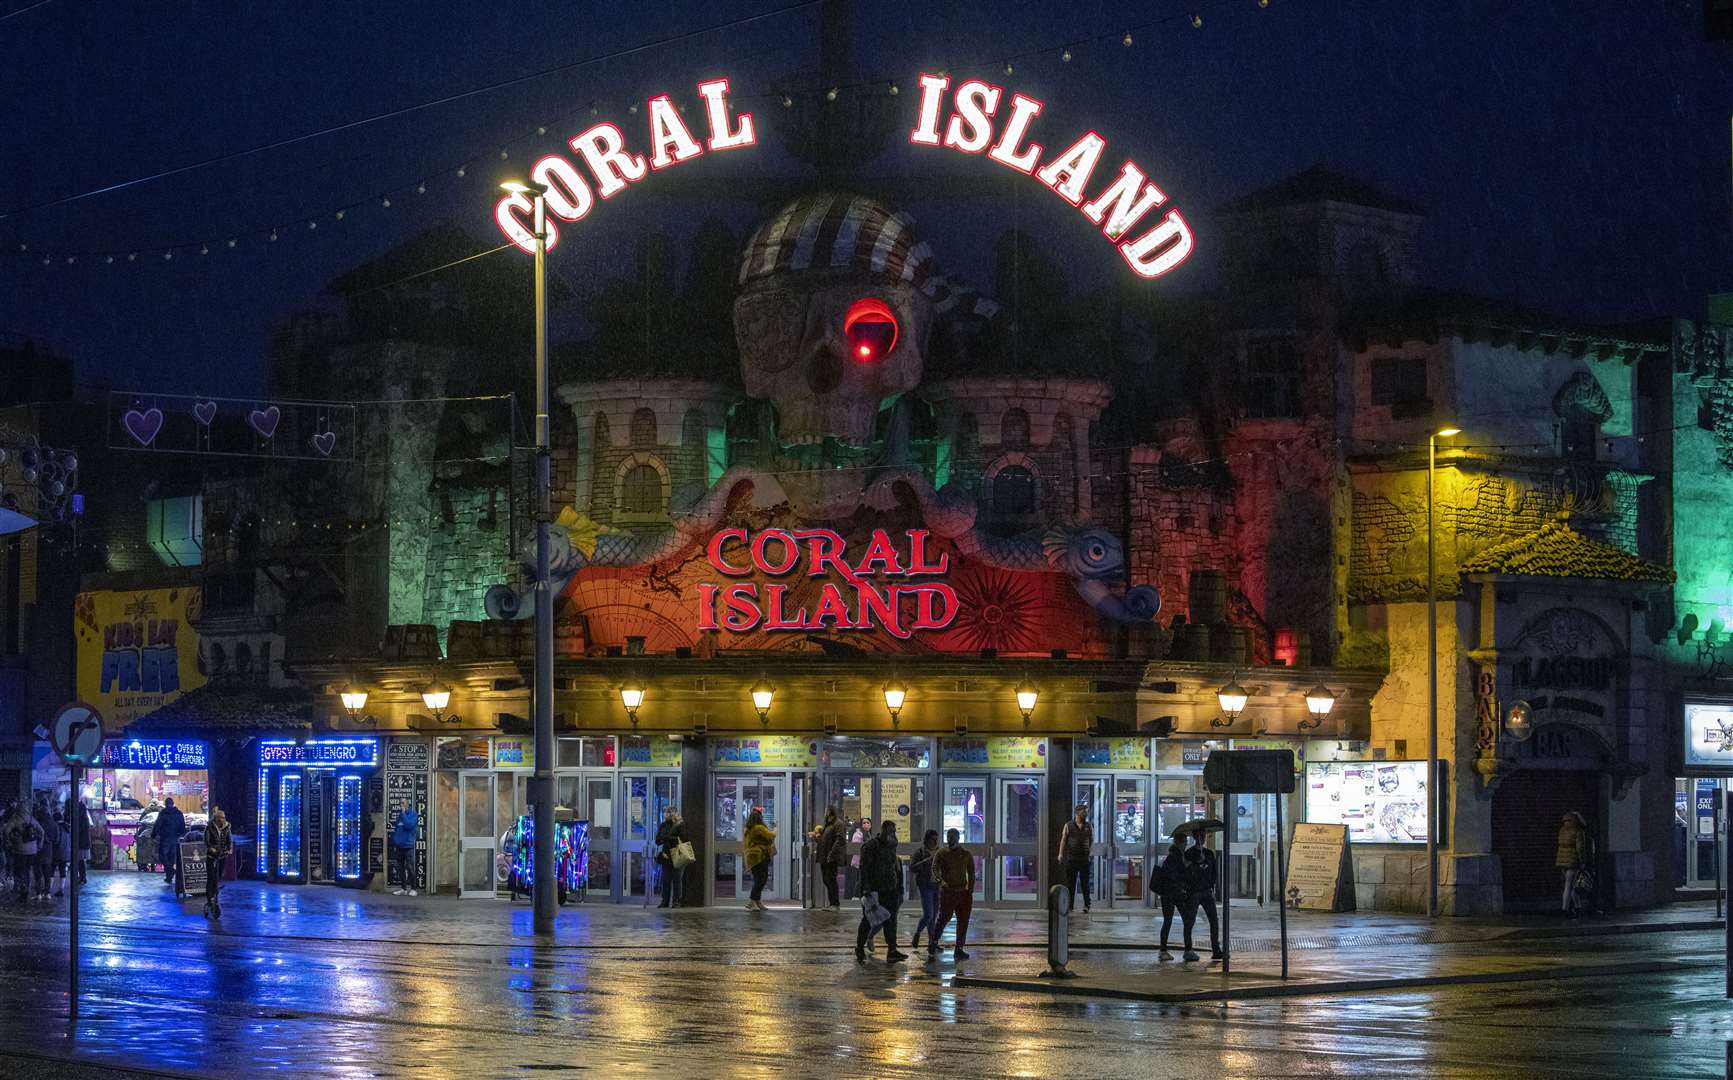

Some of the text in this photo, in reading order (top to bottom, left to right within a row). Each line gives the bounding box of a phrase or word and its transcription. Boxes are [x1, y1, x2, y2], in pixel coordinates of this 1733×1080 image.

[493, 72, 1196, 279] CORAL ISLAND
[706, 528, 948, 583] CORAL
[697, 575, 960, 638] ISLAND
[104, 622, 143, 648] KIDS
[100, 646, 180, 694] FREE
[102, 744, 173, 764] MADE FUDGE
[264, 746, 357, 760] GYPSY PEULENGRO
[398, 745, 418, 753] STOP
[1184, 753, 1201, 761] ONLY
[416, 803, 426, 887] Palmist
